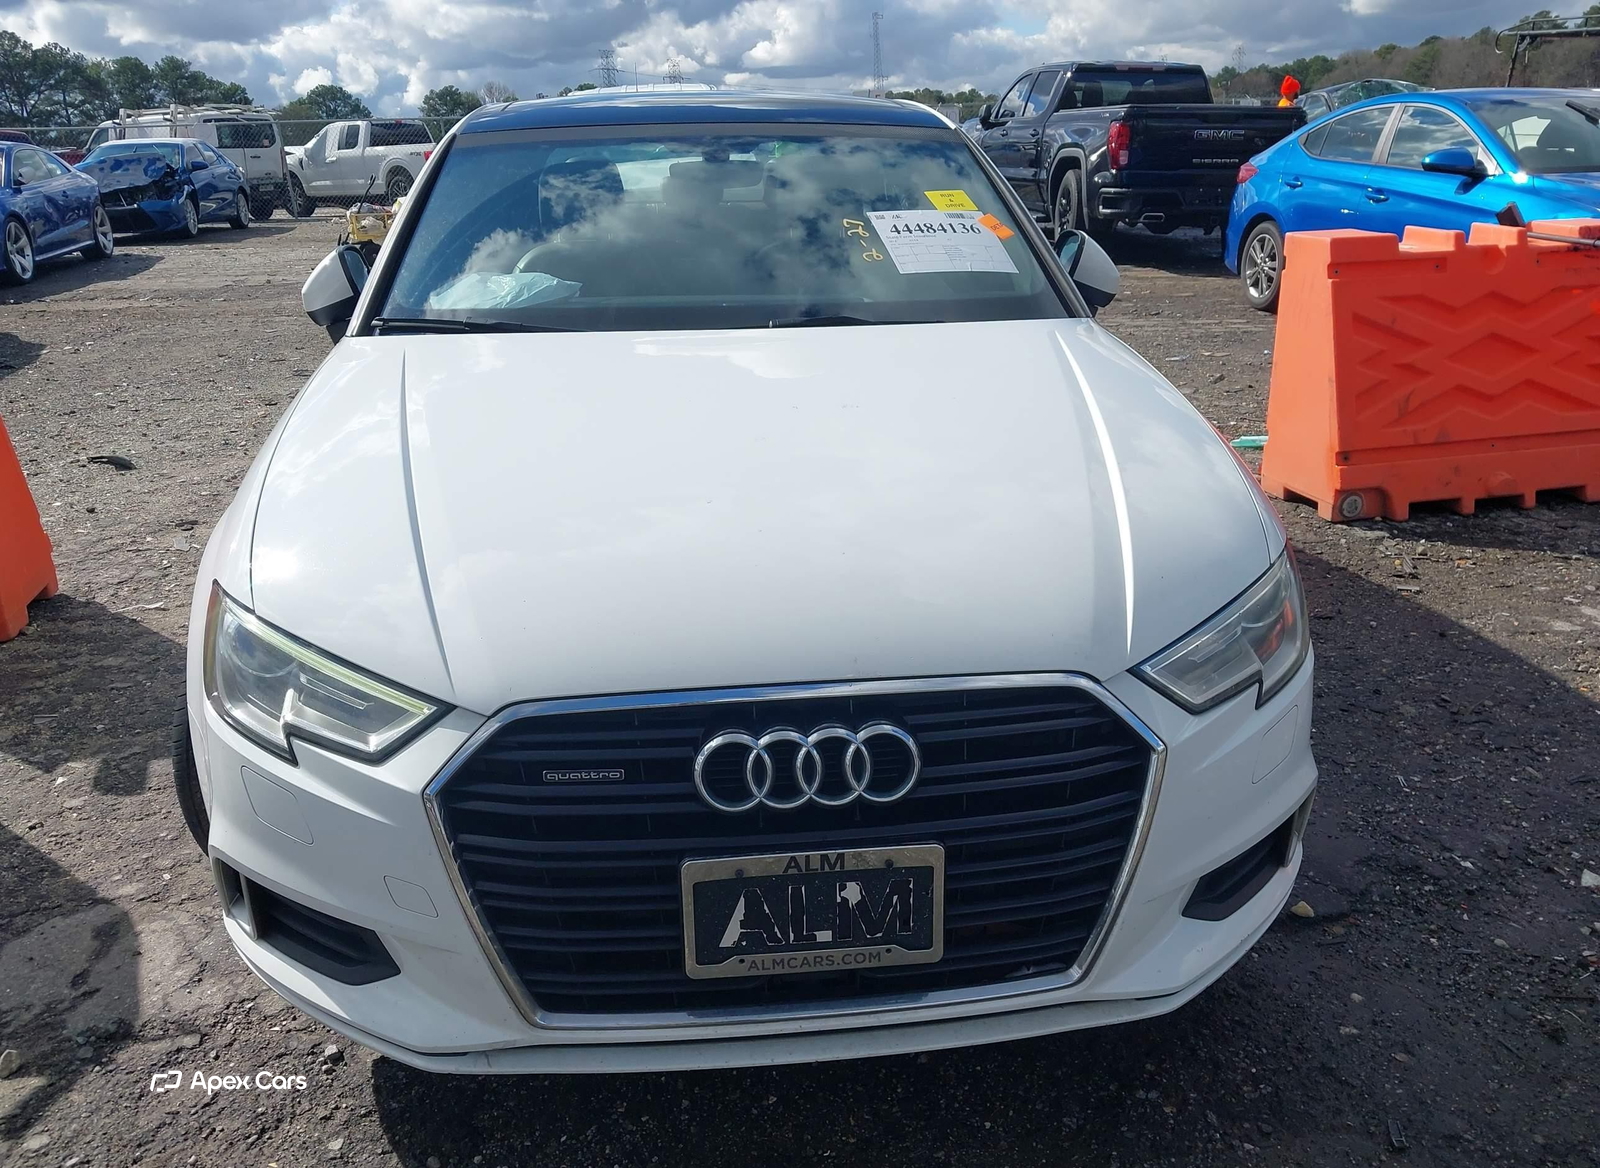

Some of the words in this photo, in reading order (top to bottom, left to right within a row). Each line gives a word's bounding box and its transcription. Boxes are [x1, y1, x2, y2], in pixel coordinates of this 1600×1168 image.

[1194, 129, 1245, 140] GMC
[890, 222, 981, 235] 44484136
[547, 771, 620, 781] quattro
[782, 853, 845, 874] ALM
[719, 878, 913, 948] ALM
[747, 952, 882, 971] ALMCARS.COM
